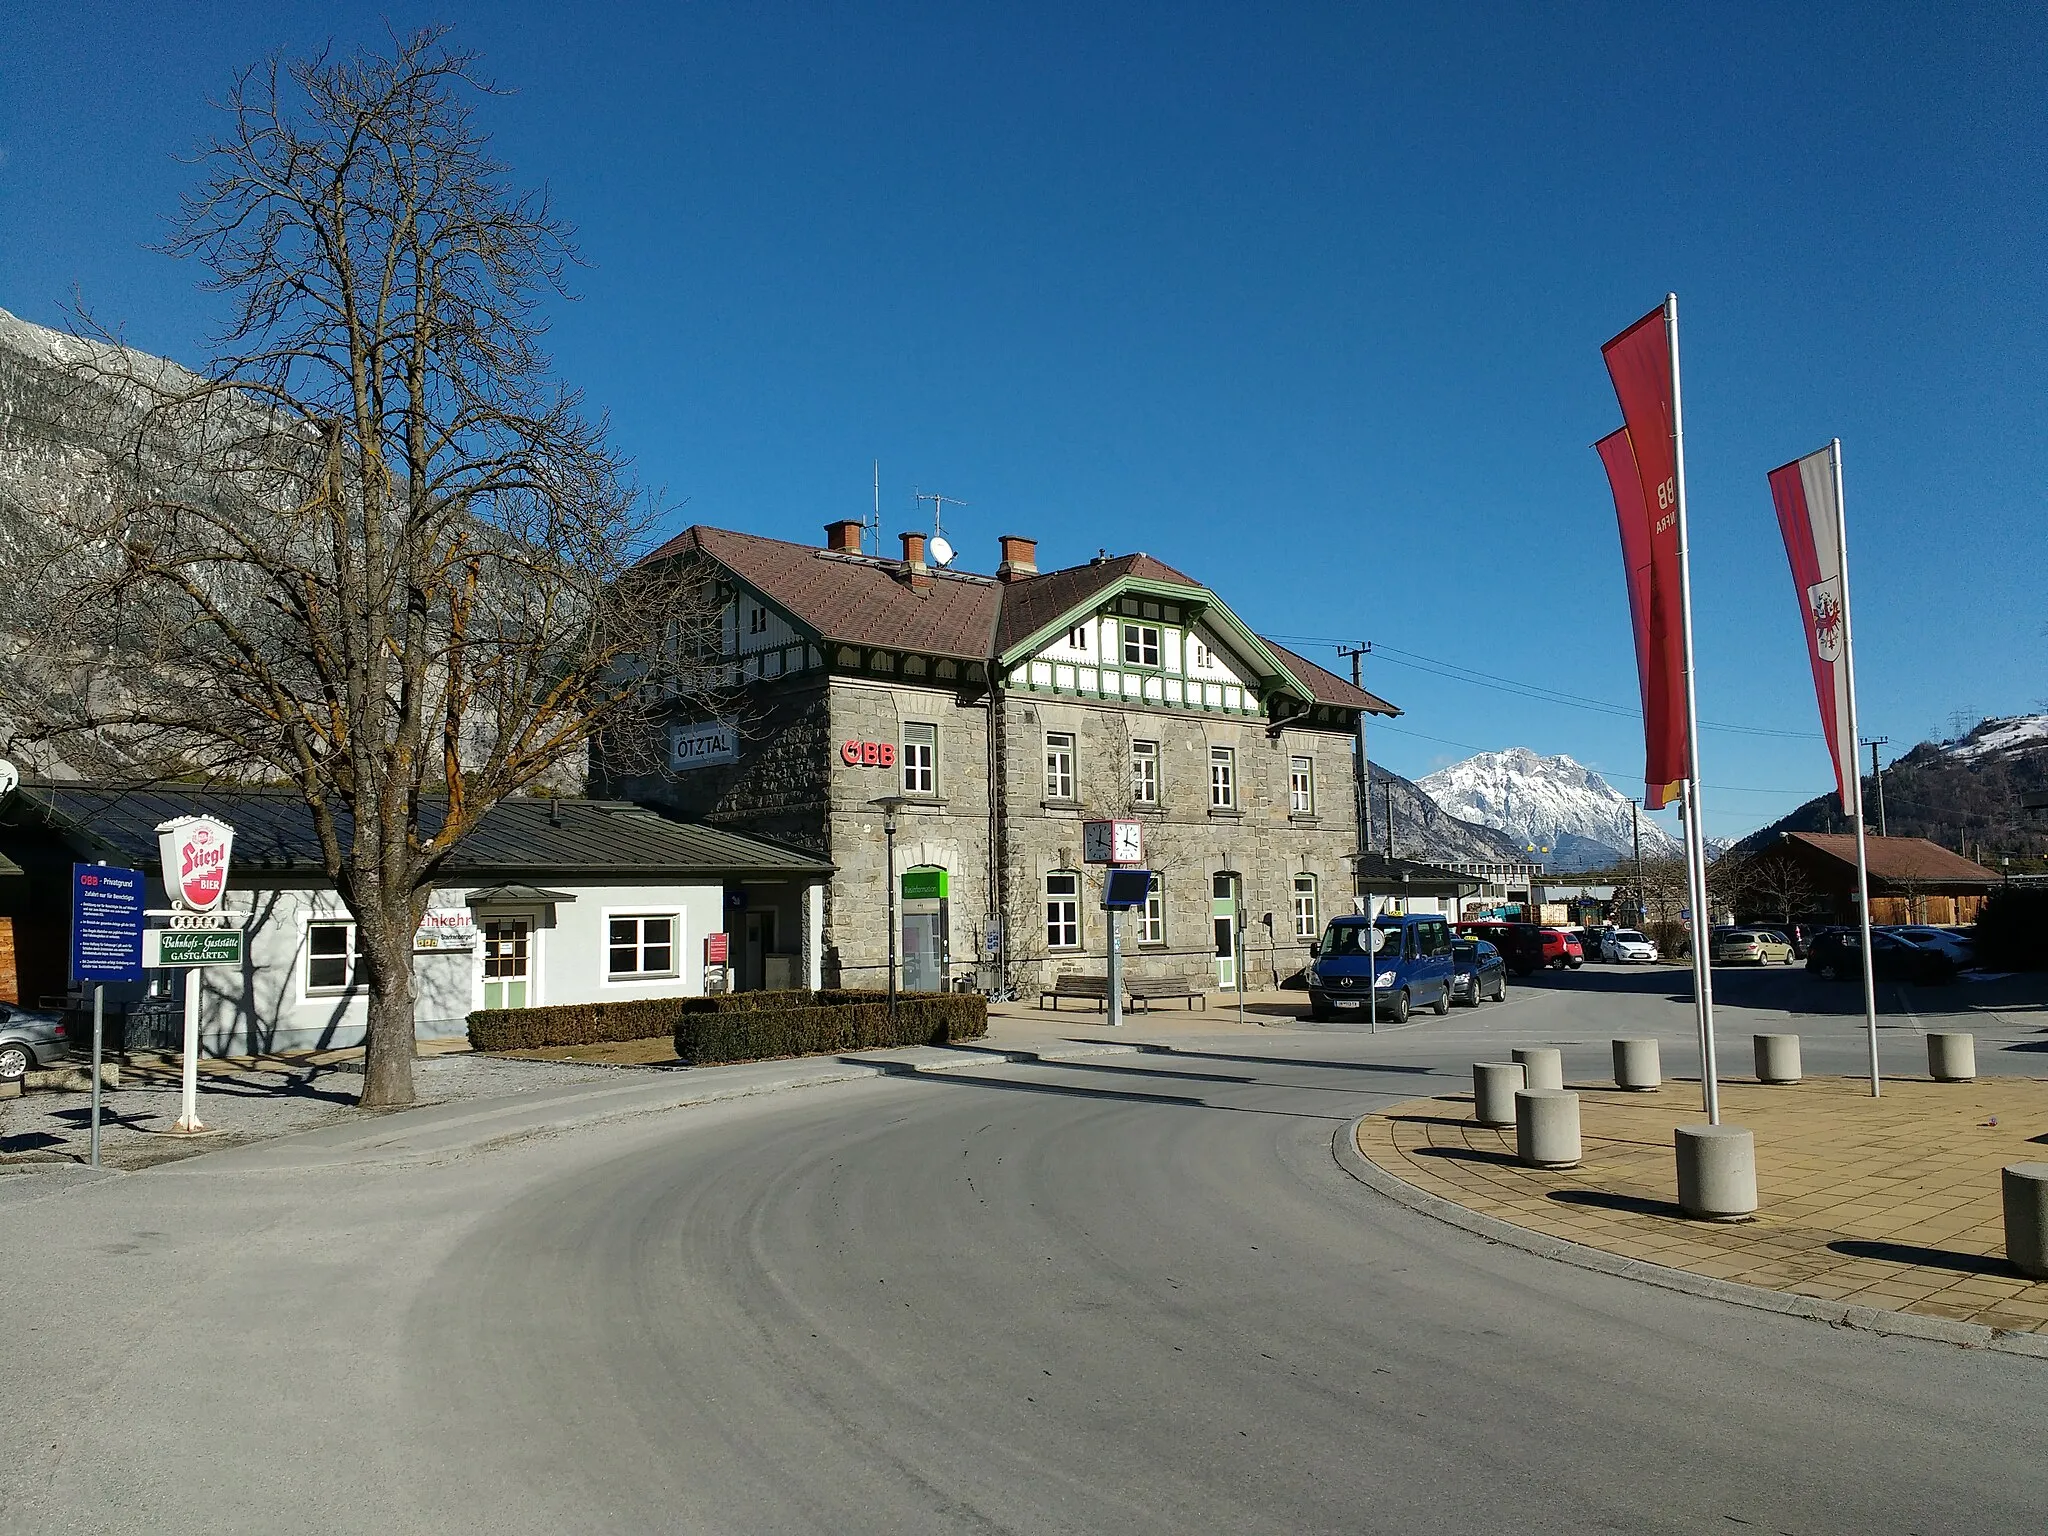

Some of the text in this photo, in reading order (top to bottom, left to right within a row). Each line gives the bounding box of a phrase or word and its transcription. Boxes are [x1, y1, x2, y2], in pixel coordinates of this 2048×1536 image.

[677, 734, 731, 758] ÖTZTAL
[841, 739, 895, 766] ÖBB
[182, 842, 225, 878] Stiegl
[103, 877, 133, 889] Privatgrund
[200, 879, 220, 890] BIER
[170, 950, 230, 961] GASTGARTEN
